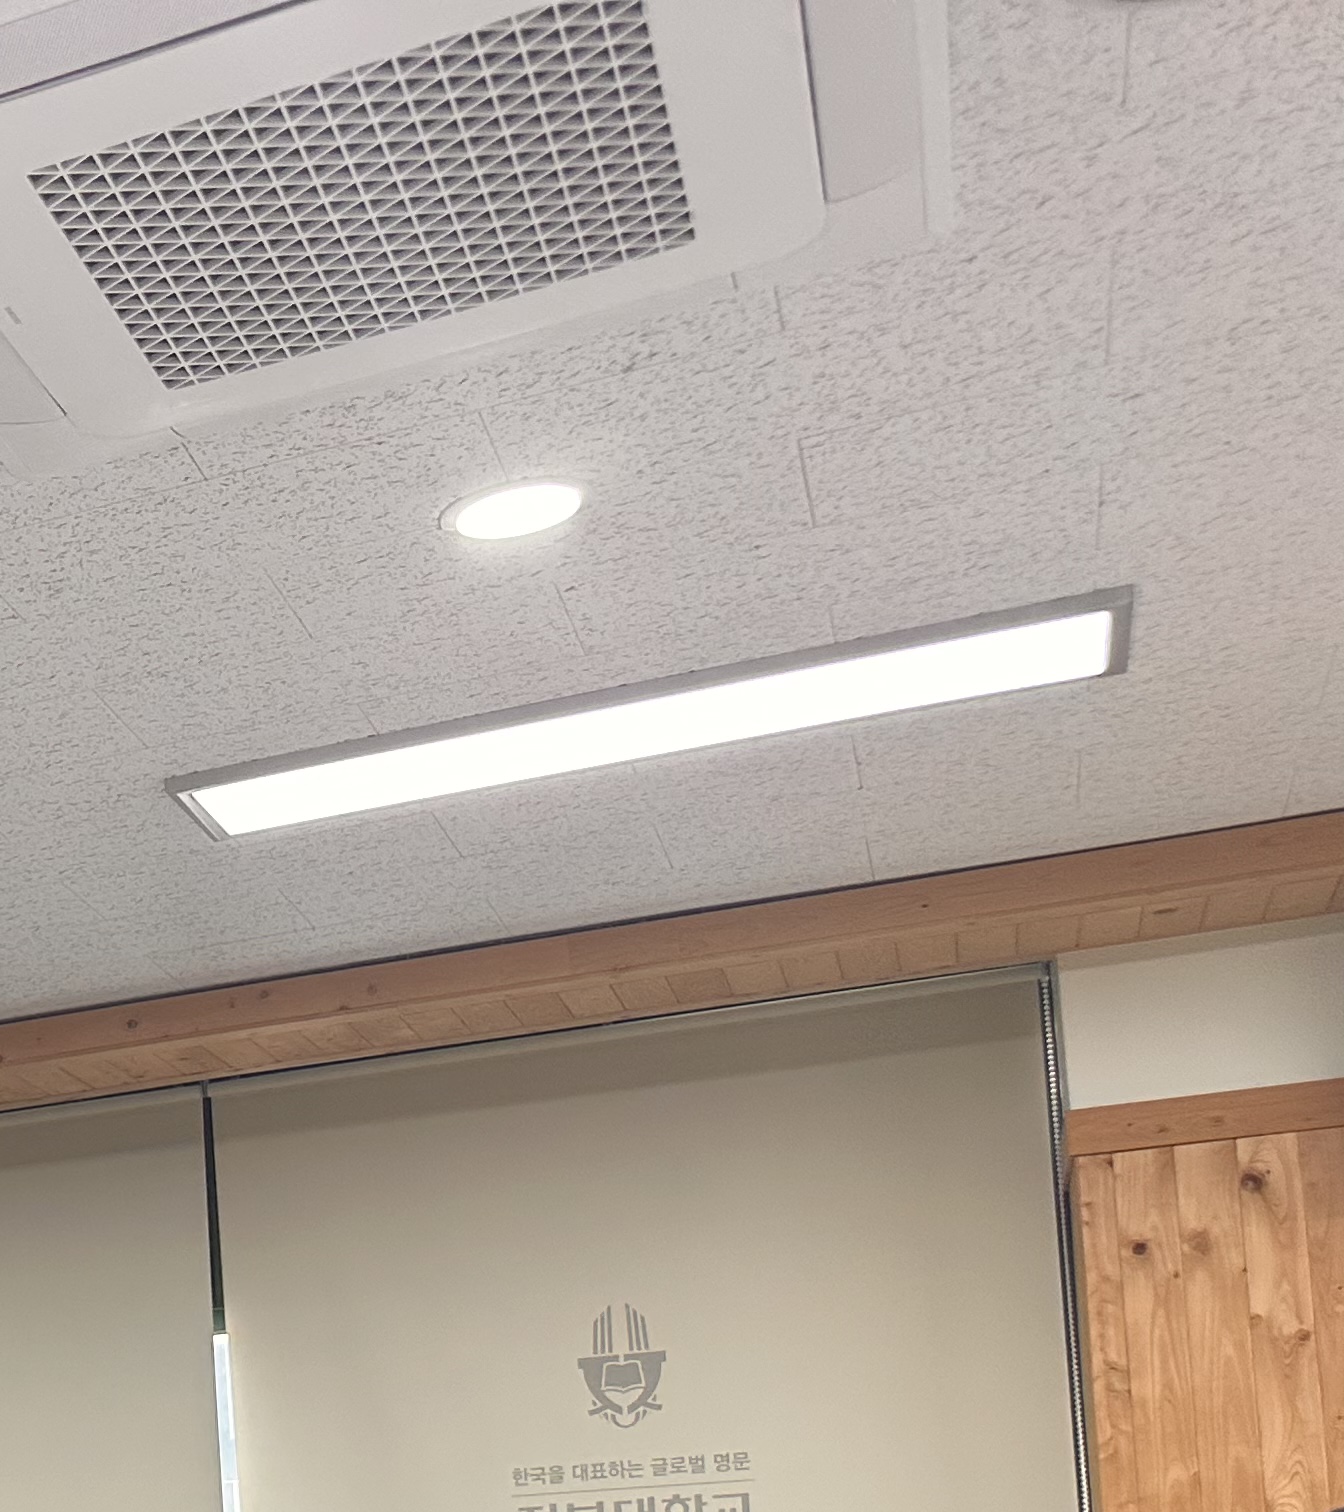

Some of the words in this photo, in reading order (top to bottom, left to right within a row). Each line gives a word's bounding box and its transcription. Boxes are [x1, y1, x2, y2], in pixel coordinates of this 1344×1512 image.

[512, 1466, 565, 1487] 한국을
[572, 1460, 644, 1481] 대표하는
[650, 1454, 706, 1477] 글로벌
[713, 1452, 751, 1472] 명문
